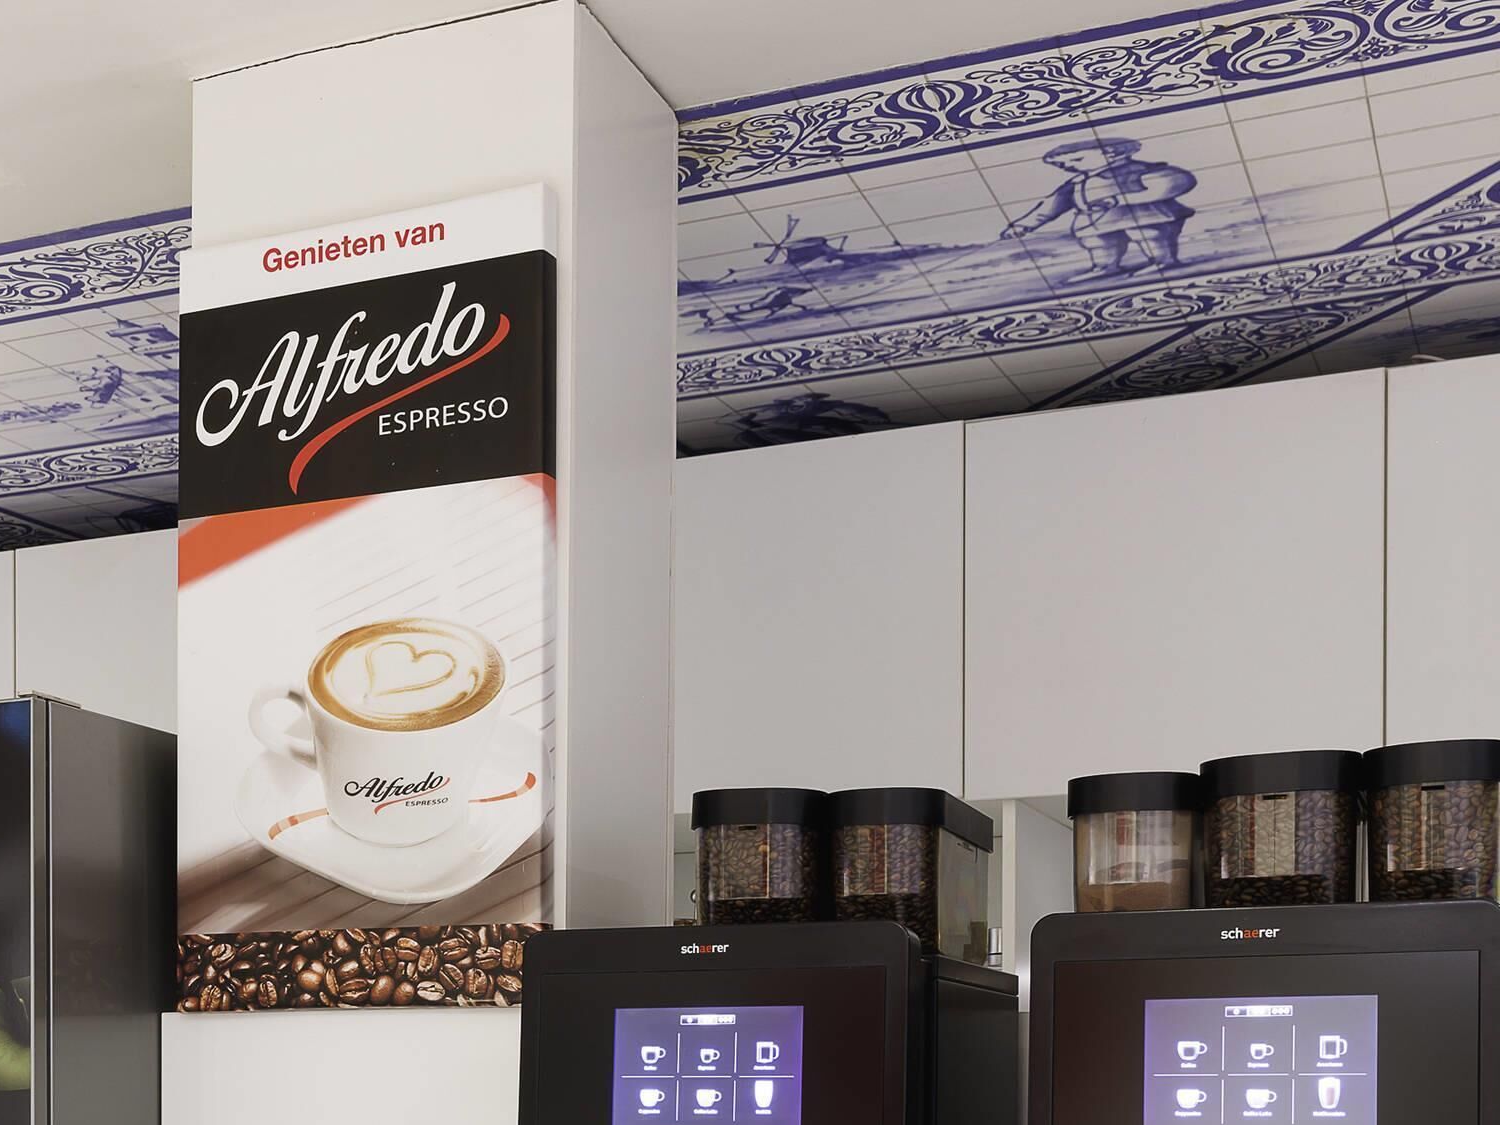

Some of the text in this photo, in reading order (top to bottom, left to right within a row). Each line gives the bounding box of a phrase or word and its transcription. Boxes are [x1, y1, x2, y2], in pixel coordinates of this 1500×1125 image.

[262, 222, 445, 273] Genieten van
[195, 281, 486, 447] Alfredo
[378, 396, 509, 435] ESPRESSO
[343, 771, 444, 803] Alfredo
[405, 797, 449, 807] ESPRESSO
[680, 943, 730, 954] schaerer
[1220, 927, 1280, 939] schaerer
